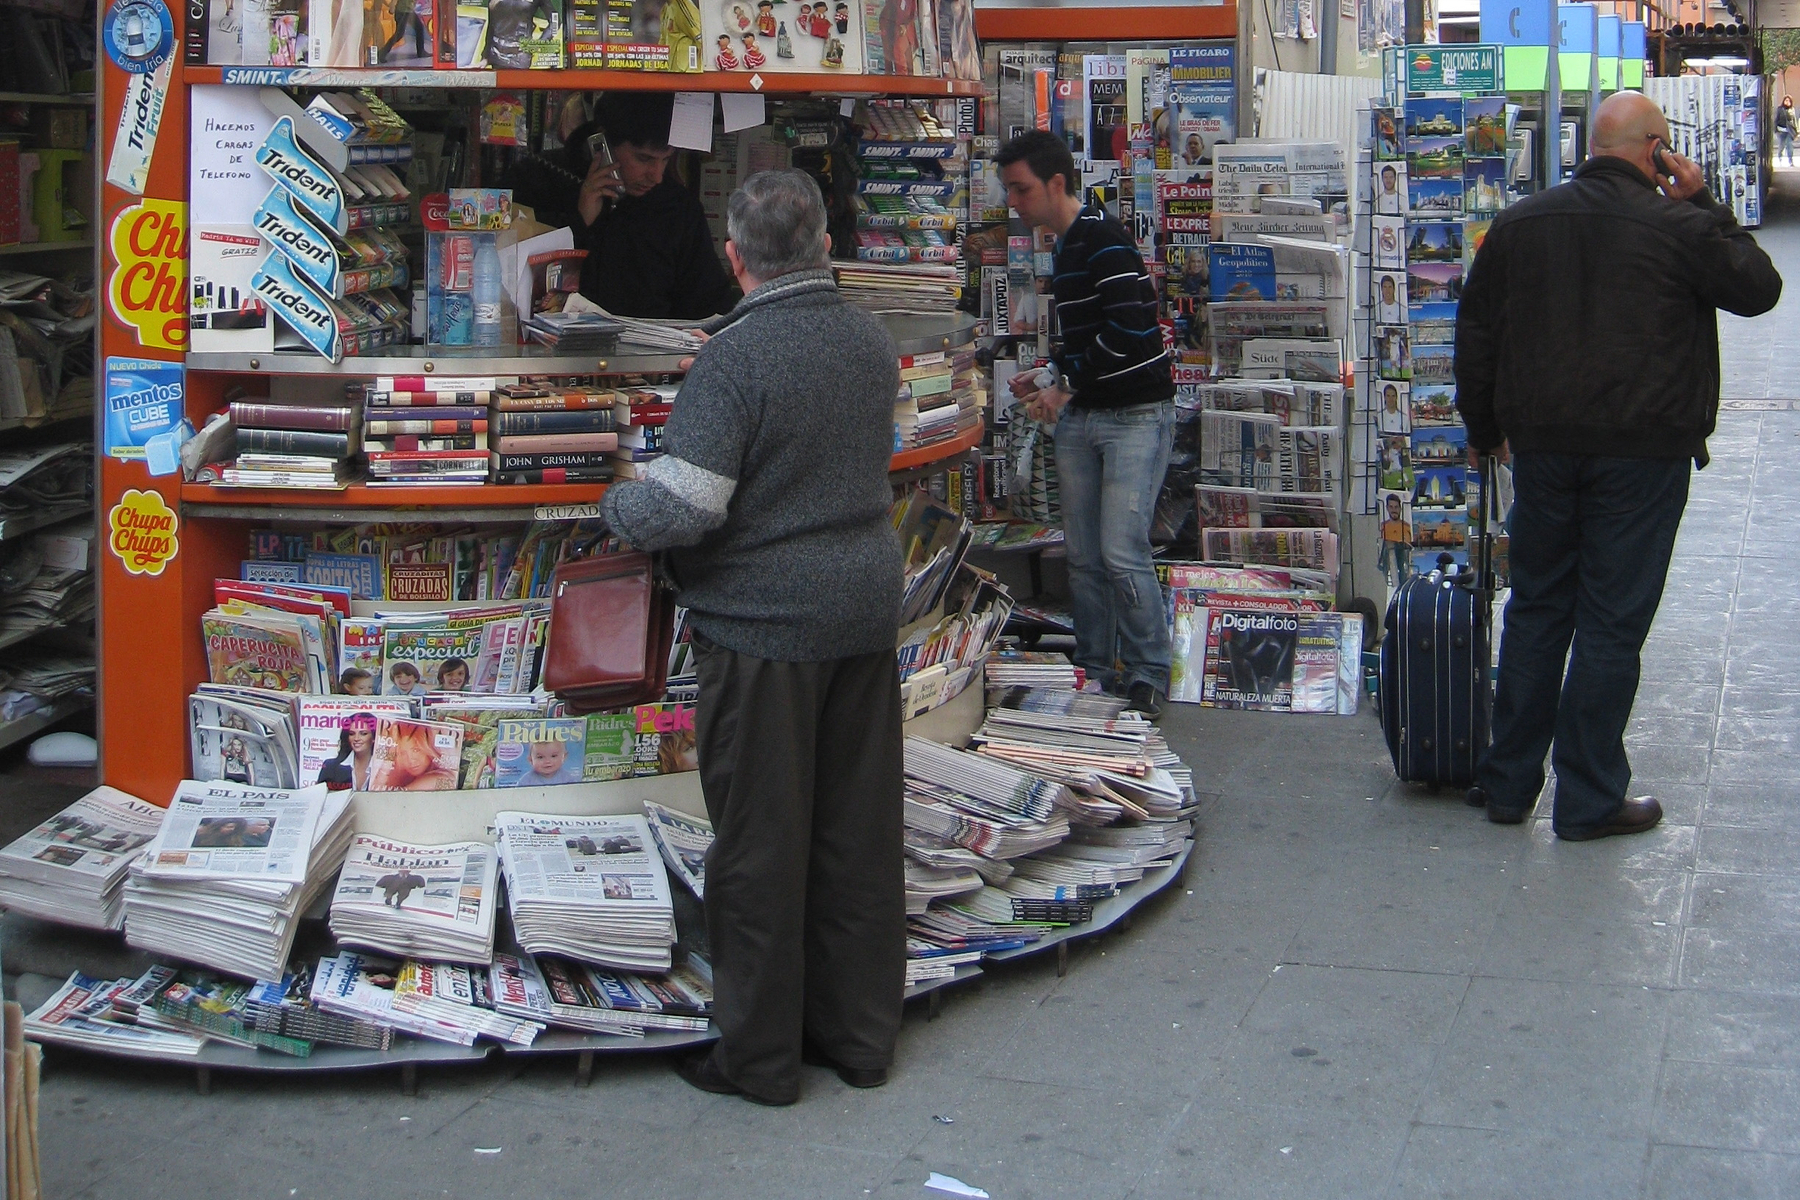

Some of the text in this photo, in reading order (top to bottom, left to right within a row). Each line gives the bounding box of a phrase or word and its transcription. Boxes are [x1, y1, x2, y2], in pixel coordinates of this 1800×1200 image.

[1172, 49, 1229, 57] LE FIGARO
[117, 55, 142, 72] bien
[607, 60, 641, 68] JORNADAS
[1441, 52, 1492, 70] EDICIONES AM
[226, 70, 282, 85] SMINT
[1171, 66, 1232, 79] IMMOBILIER
[1169, 92, 1231, 104] Observateur
[146, 87, 164, 138] Fruit
[205, 118, 255, 132] HACEMOS
[308, 107, 344, 141] HALLS
[216, 140, 253, 149] CARGAS
[230, 155, 242, 163] DE
[1296, 162, 1338, 170] International
[200, 169, 251, 179] TELEFONO
[263, 149, 336, 202] Trident
[1218, 164, 1236, 173] The
[1163, 186, 1178, 197] Le
[869, 215, 945, 226] Orbit Orbit
[259, 212, 333, 265] Trident
[222, 248, 257, 256] GRATIS
[869, 247, 945, 258] Orbit Orbit
[1231, 246, 1267, 256] El Atlas
[1219, 257, 1268, 270] Geopolítico
[257, 275, 331, 330] Trident
[996, 278, 1009, 333] JUXTAPOZ
[110, 362, 137, 370] NUEVO
[1172, 366, 1212, 381] heat
[110, 383, 183, 412] mentos
[1324, 392, 1332, 414] THE
[129, 404, 169, 423] CUBE
[506, 456, 585, 467] JOHN GRISHAM
[535, 505, 599, 520] CRUZAD
[118, 507, 172, 535] Chupa
[115, 529, 170, 565] Chups
[250, 569, 283, 579] selección
[391, 578, 448, 600] CRUZADAS
[1178, 603, 1195, 612] KIT
[1240, 601, 1288, 610] CONSOLADOR
[1222, 613, 1298, 631] Digitalfoto
[210, 635, 299, 659] CAPERUCITA
[393, 640, 475, 662] especial
[258, 656, 293, 671] ROJA
[1216, 691, 1291, 704] NATURALEZA MUERTA
[503, 722, 583, 744] Padres
[635, 734, 660, 746] 156
[303, 737, 311, 751] 9
[207, 788, 290, 799] EL PAÍS
[119, 801, 165, 817] ABC
[357, 837, 444, 855] Público
[366, 852, 449, 866] Hablan
